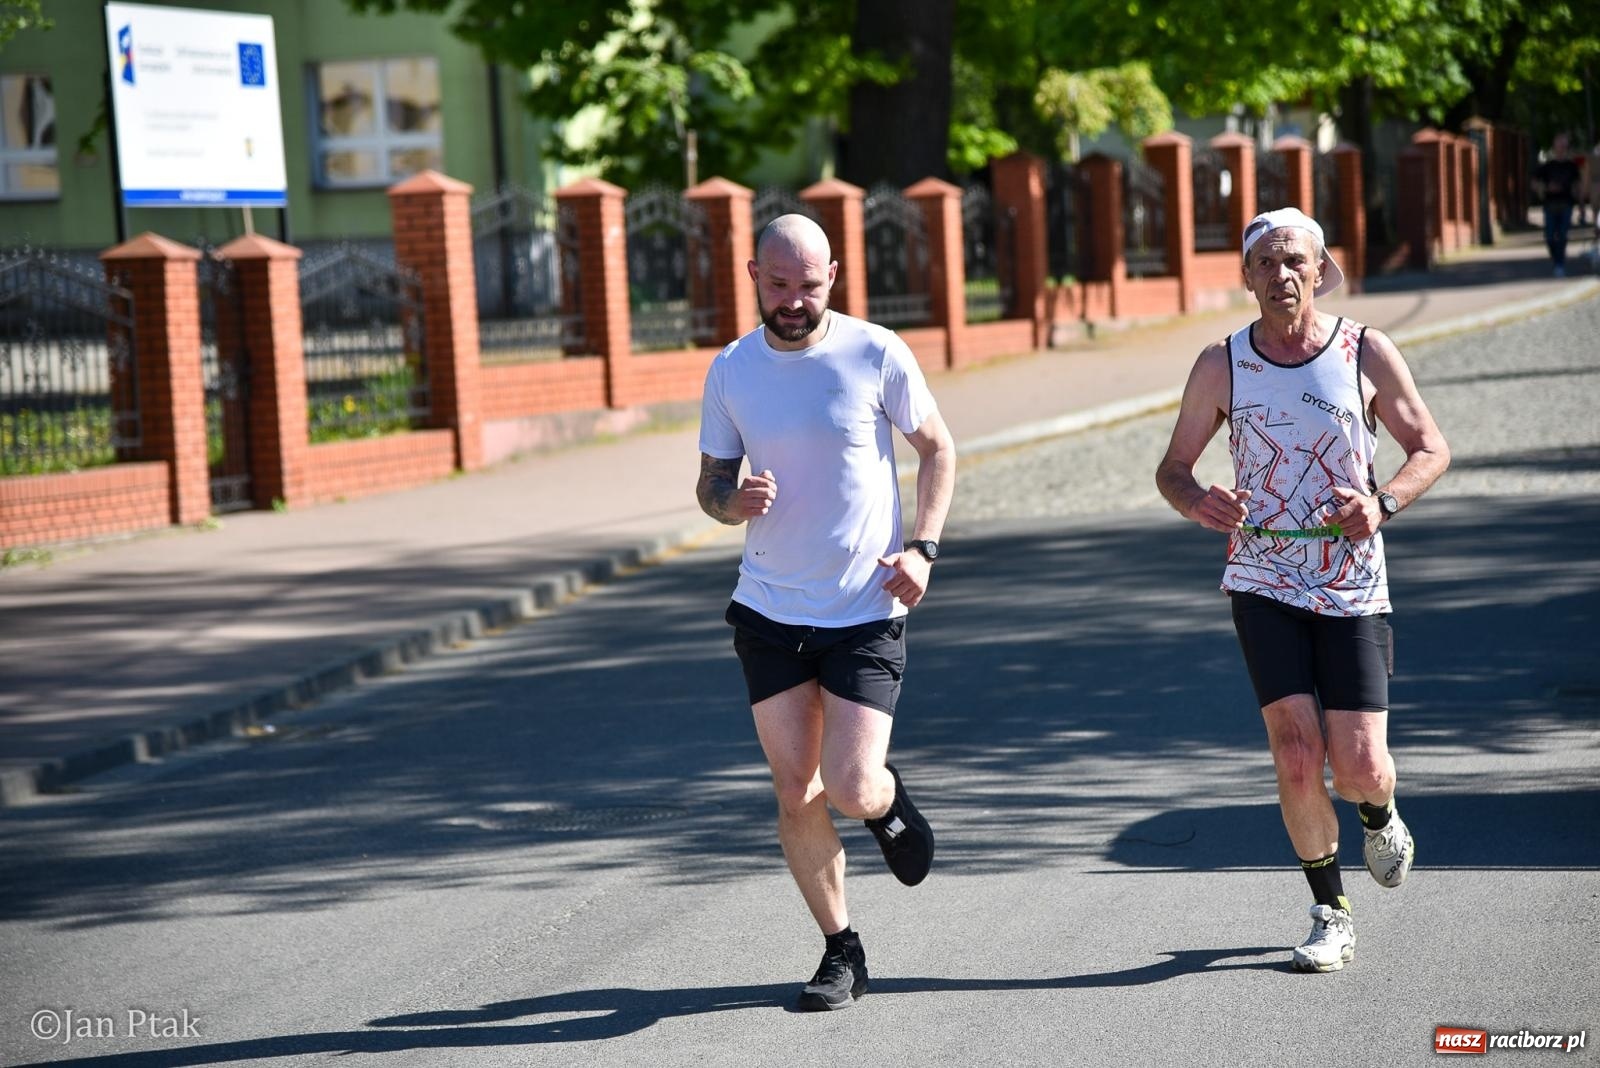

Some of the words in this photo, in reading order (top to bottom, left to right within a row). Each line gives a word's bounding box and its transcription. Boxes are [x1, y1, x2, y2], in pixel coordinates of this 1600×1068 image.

[1237, 359, 1264, 373] deep
[1301, 392, 1353, 423] DYCZUS
[1384, 846, 1407, 880] CRAFT
